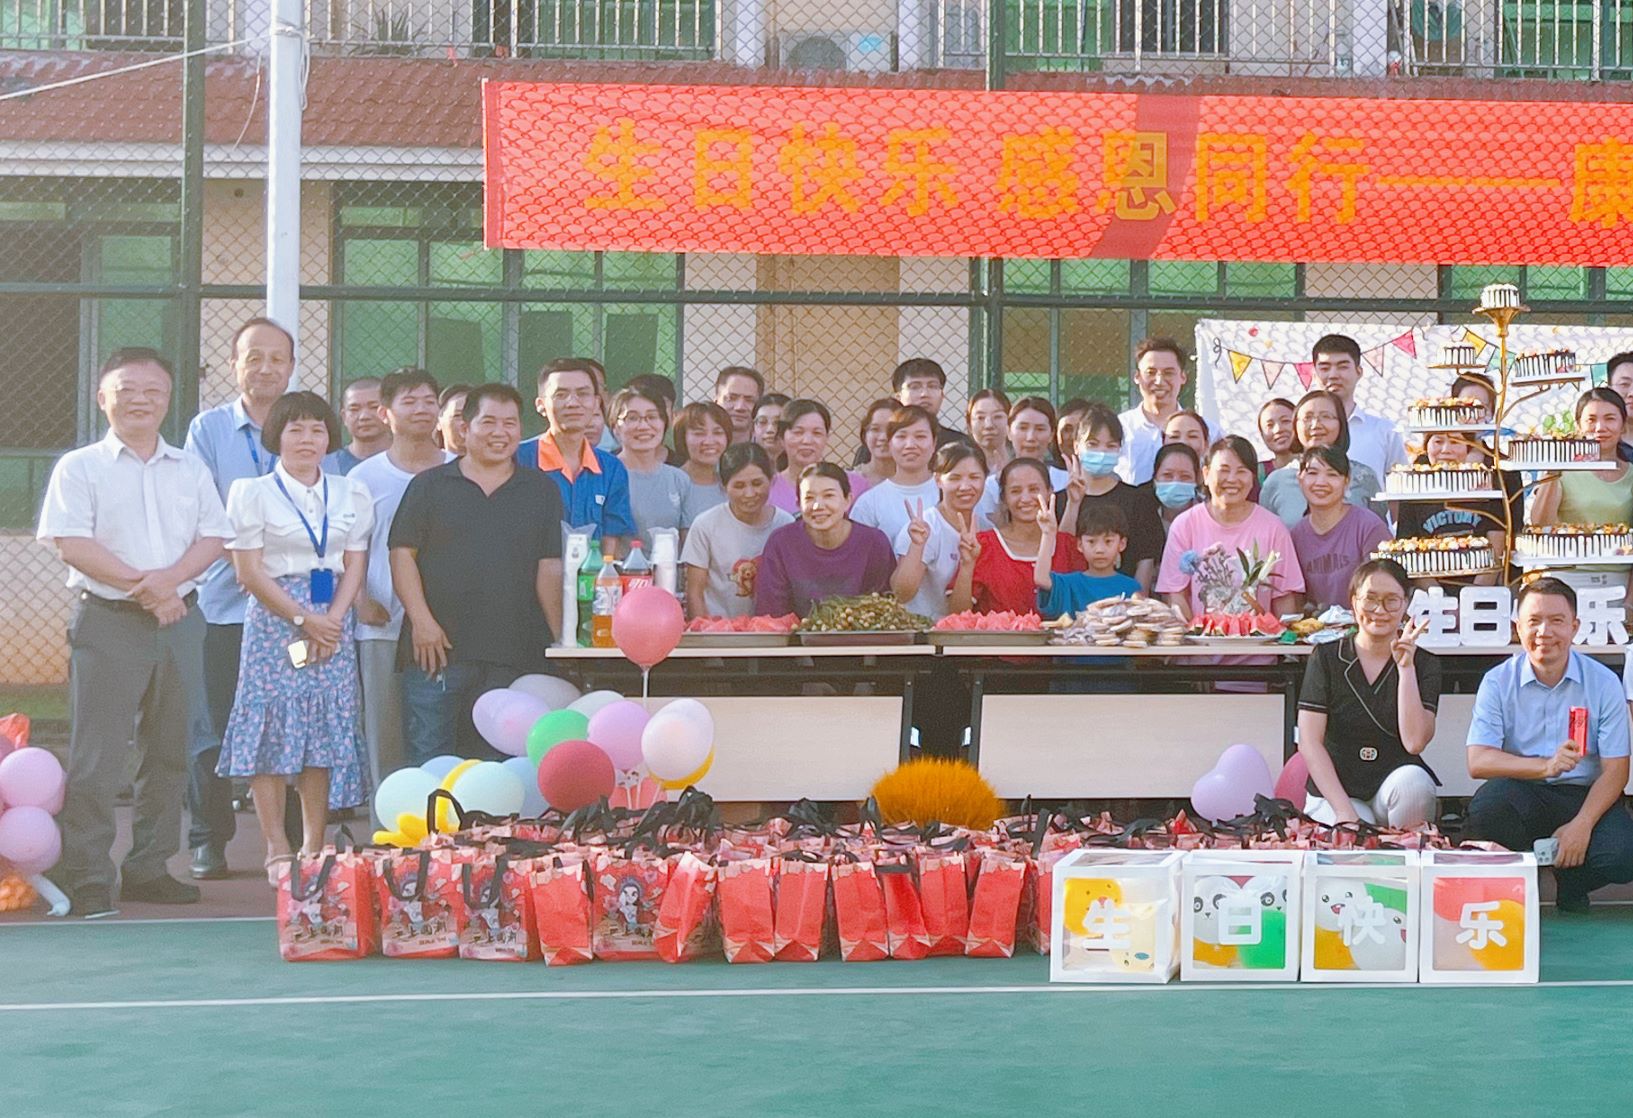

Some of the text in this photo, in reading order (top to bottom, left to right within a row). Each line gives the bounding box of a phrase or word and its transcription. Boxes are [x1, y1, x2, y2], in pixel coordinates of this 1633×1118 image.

[582, 118, 958, 216] 生日快乐
[1422, 510, 1482, 534] VICTORY
[1407, 586, 1629, 647] 生日乐
[1082, 896, 1506, 952] 生日快乐
